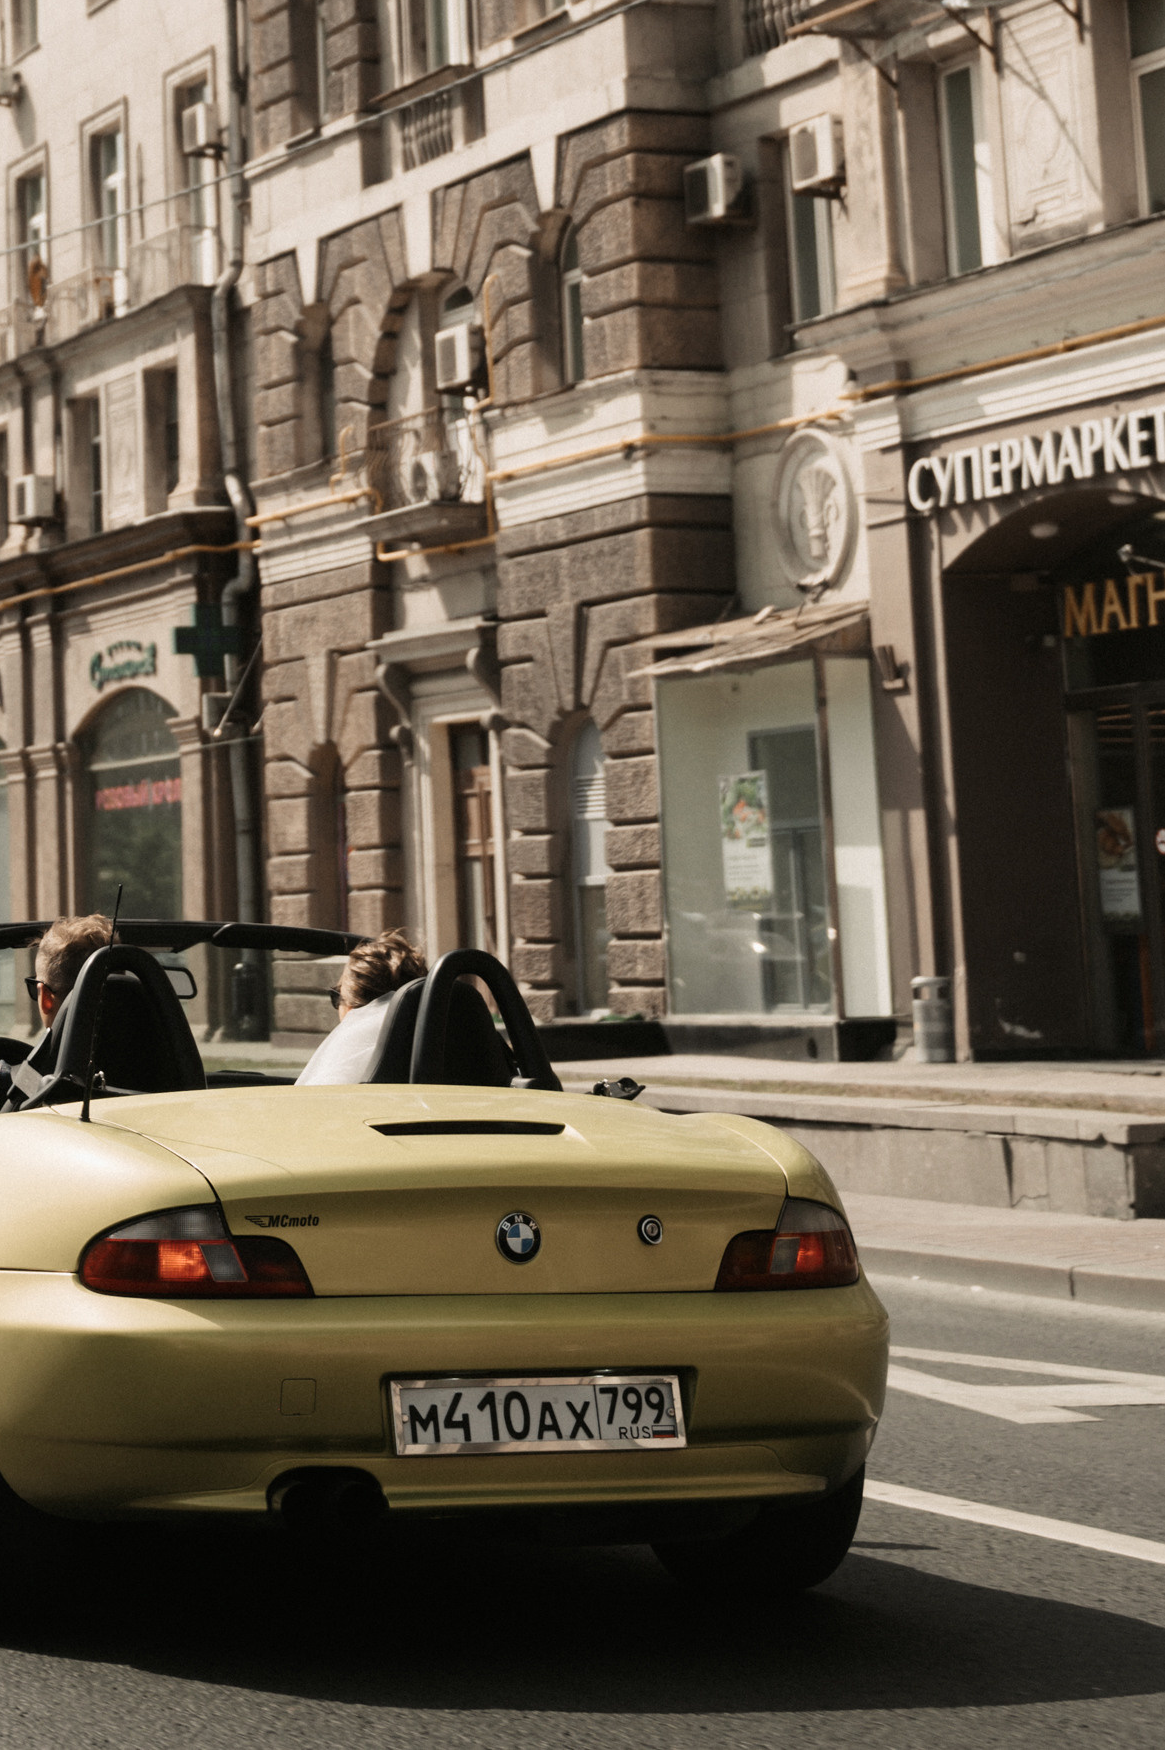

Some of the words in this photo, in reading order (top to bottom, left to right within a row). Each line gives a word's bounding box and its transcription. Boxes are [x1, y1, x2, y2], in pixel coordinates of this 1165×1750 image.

[908, 406, 1165, 512] СУПЕРМАРКЕТ
[268, 1214, 320, 1228] MCmoto
[501, 1214, 538, 1231] BMW
[599, 1386, 666, 1426] 799
[619, 1425, 651, 1440] RUS
